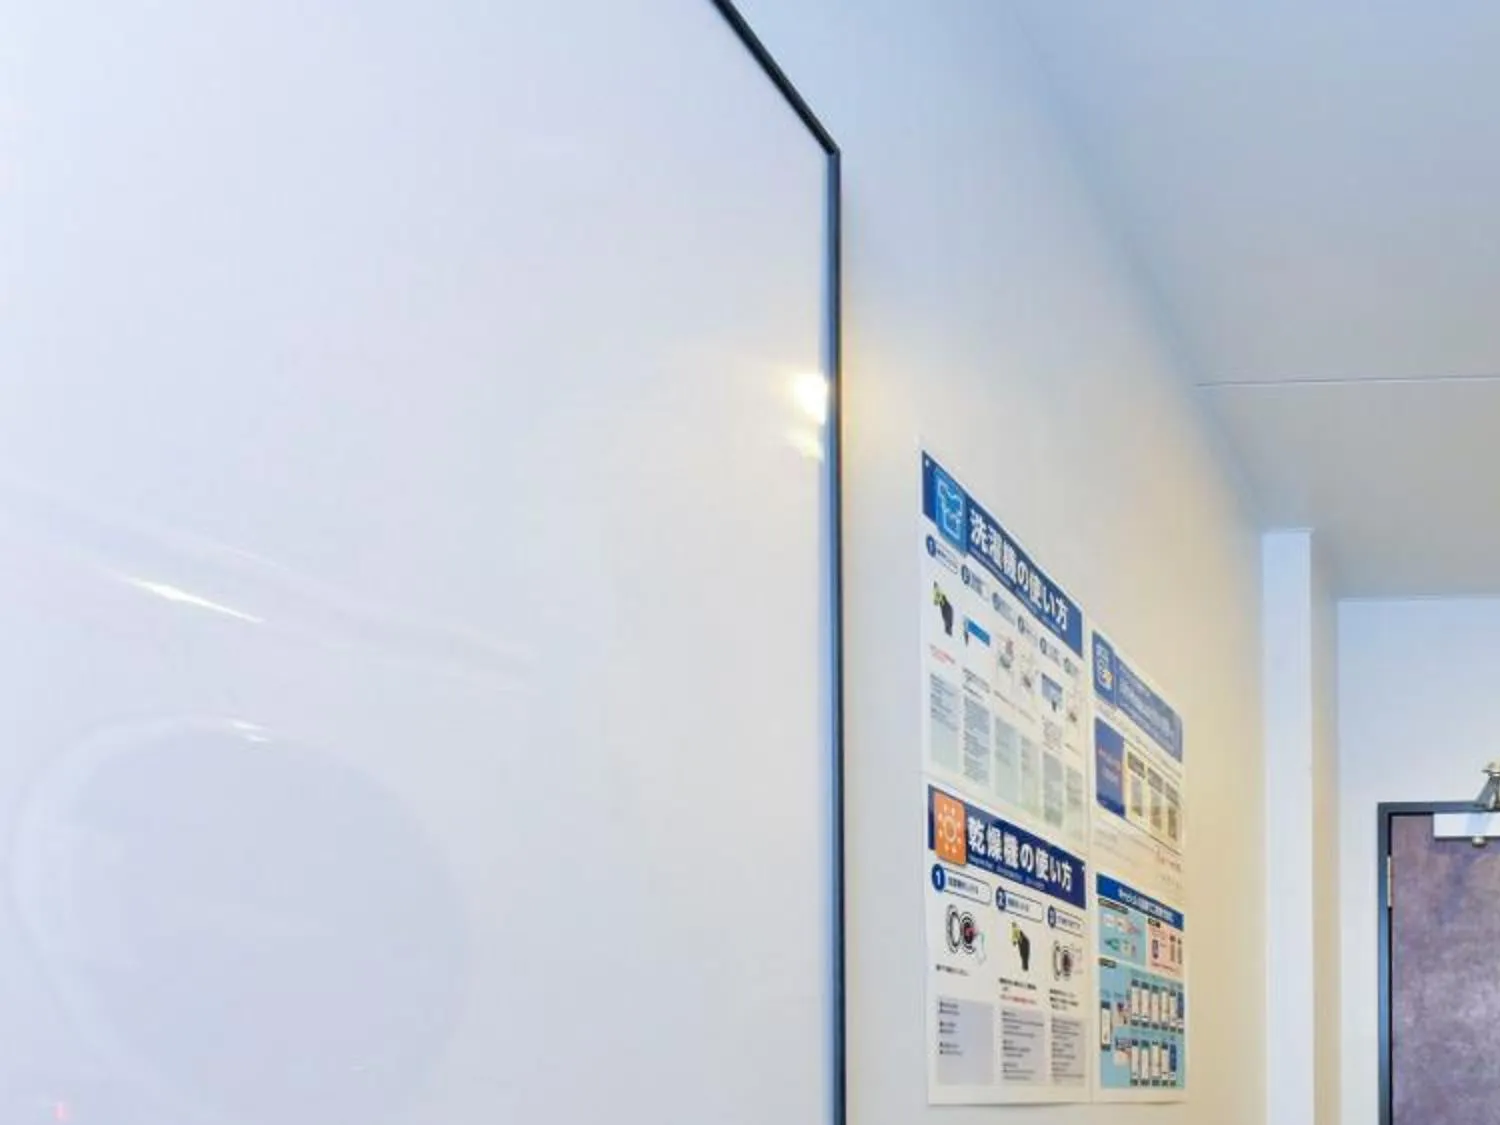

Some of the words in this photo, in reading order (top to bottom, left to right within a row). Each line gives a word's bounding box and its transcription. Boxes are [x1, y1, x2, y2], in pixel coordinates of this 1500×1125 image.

[968, 507, 1068, 631] 洗濯機の使い方
[967, 815, 1073, 893] 乾燥機の使い方
